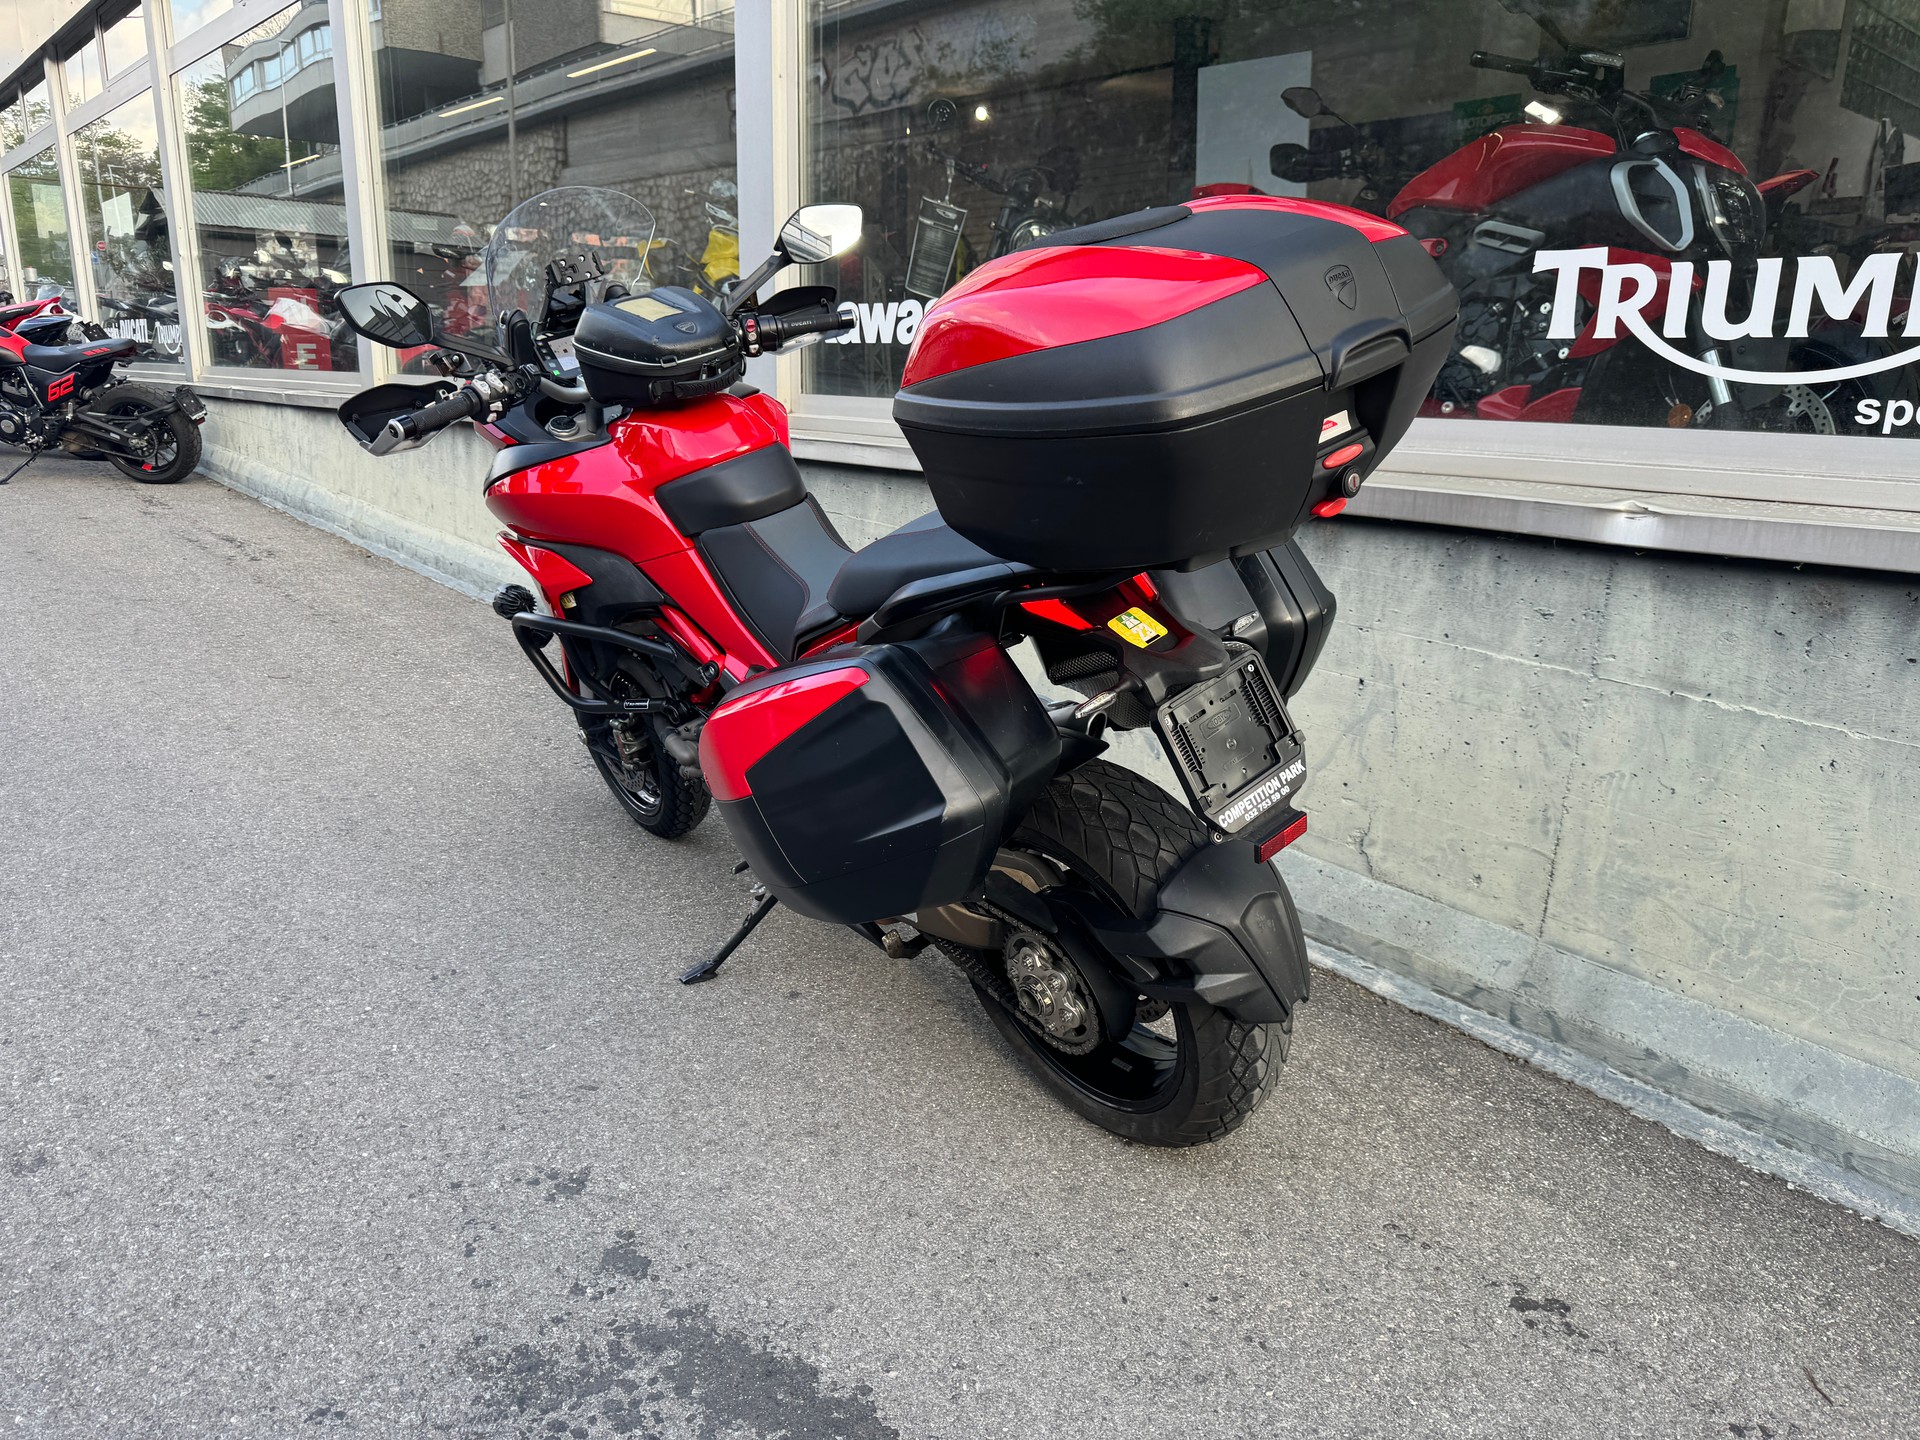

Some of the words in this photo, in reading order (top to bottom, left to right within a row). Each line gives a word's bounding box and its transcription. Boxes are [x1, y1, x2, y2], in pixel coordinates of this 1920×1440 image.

[120, 318, 149, 344] DUCATI
[825, 299, 939, 345] awa
[48, 373, 75, 402] 62
[1854, 398, 1920, 434] sp
[1218, 776, 1282, 828] COMPETITION
[1279, 759, 1306, 784] PARK
[1244, 808, 1259, 821] 032
[1257, 798, 1272, 812] 753
[1271, 792, 1281, 803] 59
[1280, 785, 1291, 796] 00
